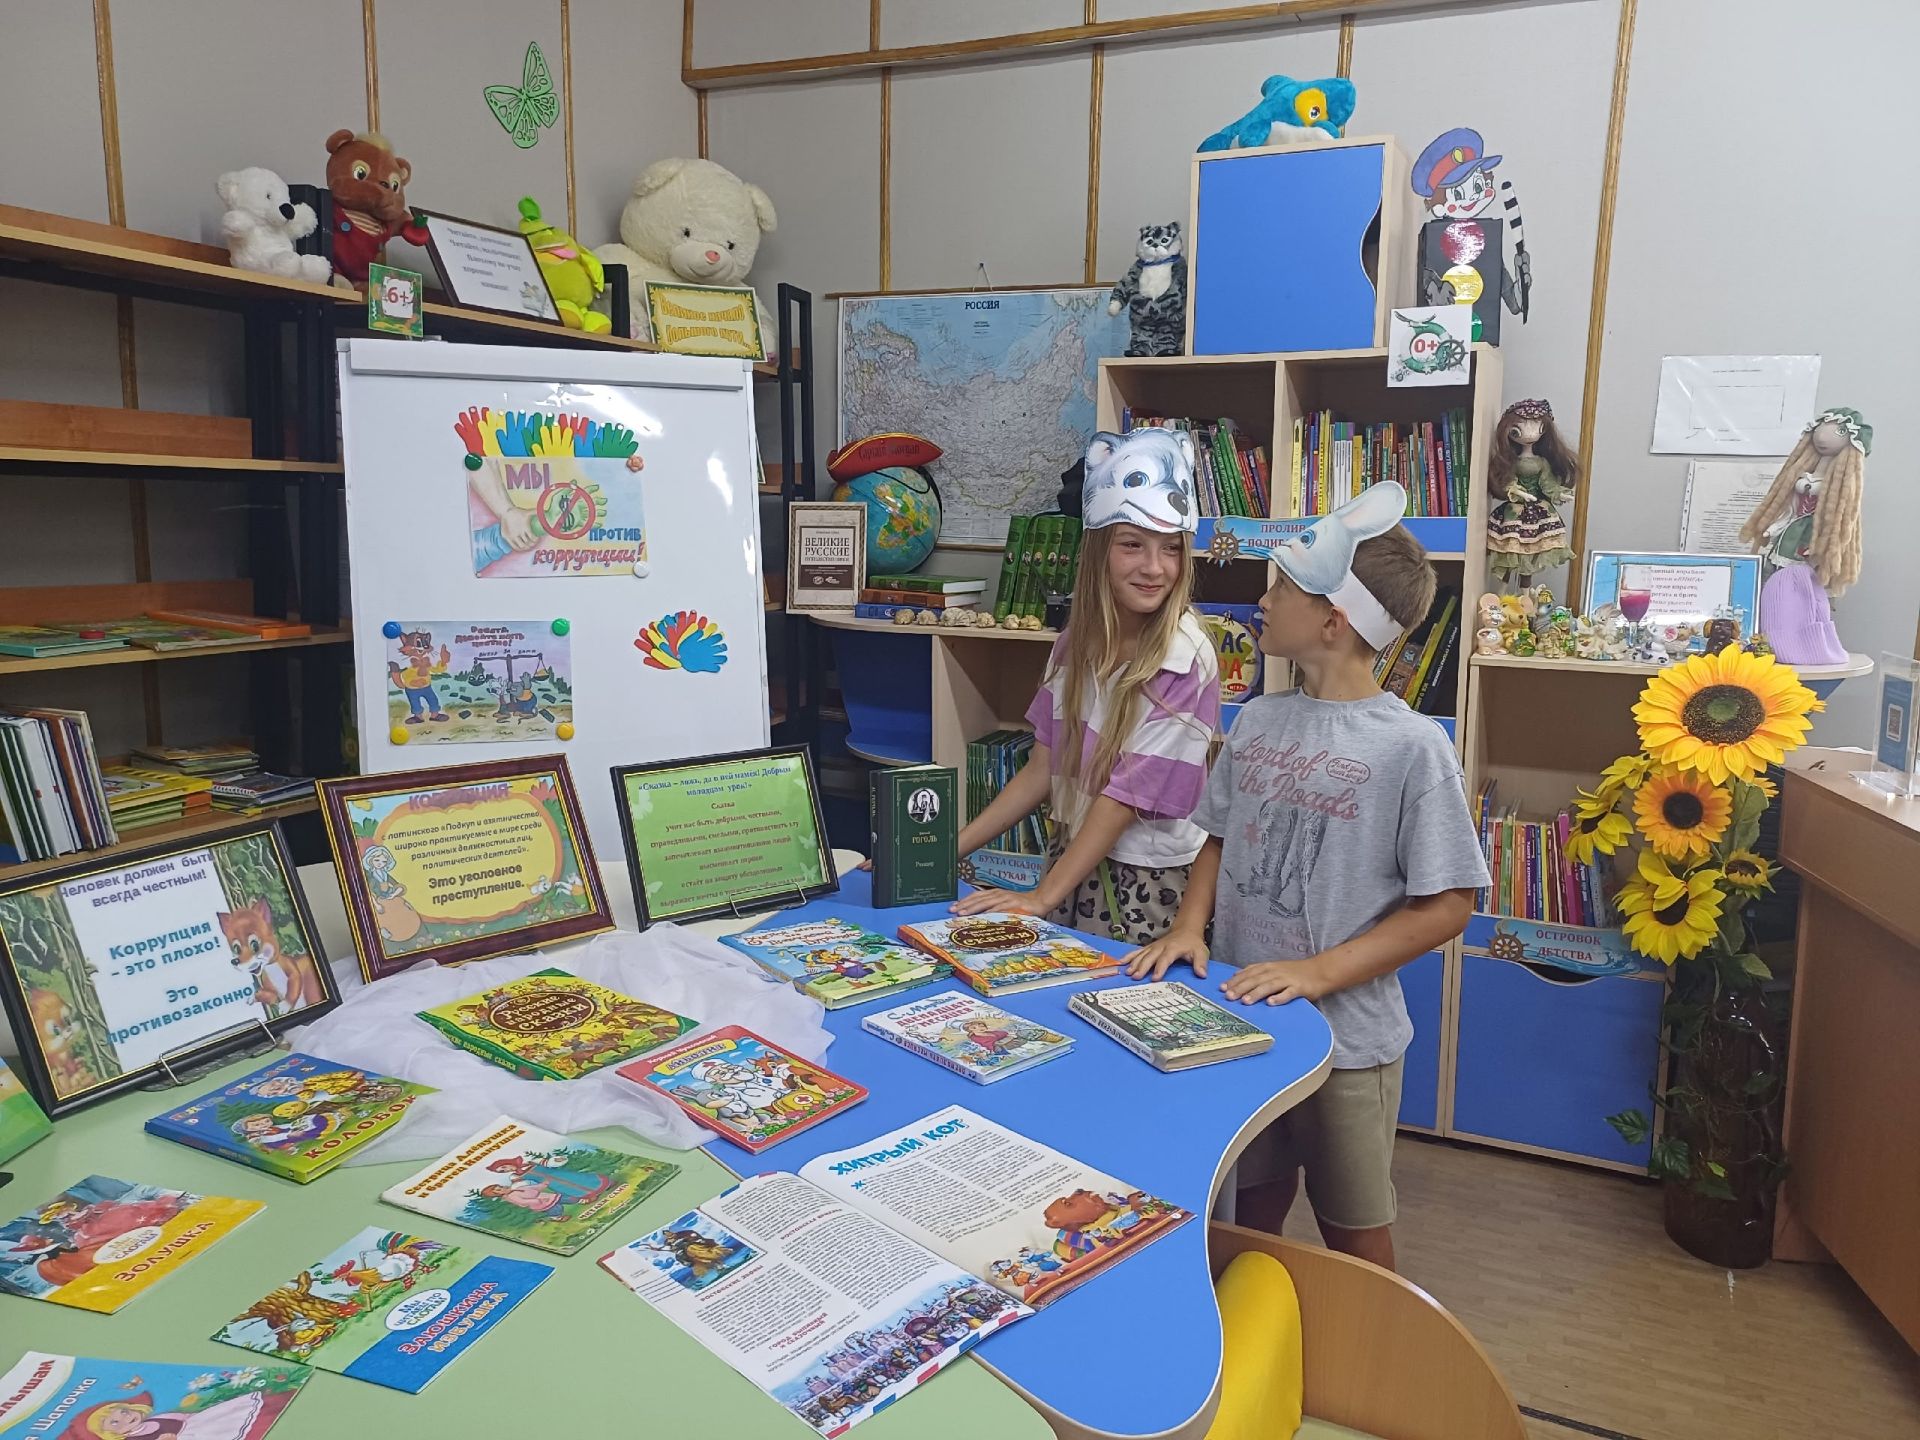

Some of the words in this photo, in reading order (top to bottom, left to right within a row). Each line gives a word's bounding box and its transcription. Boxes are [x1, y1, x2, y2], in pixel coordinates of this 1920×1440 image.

[387, 286, 409, 303] 6+
[964, 300, 1000, 310] РОССИЯ
[1413, 338, 1438, 353] 0+
[505, 463, 551, 490] МЫ
[589, 527, 642, 542] ПРОТИВ
[805, 537, 850, 547] ВЕЛИКИЕ
[805, 547, 850, 556] РУССКИЕ
[1233, 733, 1300, 769] Lord
[1292, 750, 1329, 781] of
[1238, 764, 1267, 796] the
[394, 838, 428, 851] широко
[499, 824, 519, 834] мире
[520, 821, 542, 832] среди
[475, 818, 482, 827] и
[912, 835, 938, 844] ГОГОЛЬ
[411, 847, 457, 862] различных
[422, 855, 482, 871] политических
[122, 861, 175, 885] должен
[181, 852, 215, 869] быть
[428, 874, 456, 889] Это
[457, 863, 523, 887] уголовное
[998, 872, 1026, 881] ТУКАЯ
[92, 887, 141, 908] всегда
[142, 868, 208, 894] честным!
[432, 877, 526, 906] преступление.
[108, 920, 213, 961] Коррупция
[1243, 927, 1270, 943] OOD
[1536, 929, 1602, 946] ОСТРОВОК
[124, 959, 156, 978] это
[161, 936, 221, 964] плохо!
[1537, 946, 1593, 961] ДЕТСТВА
[165, 983, 200, 1003] Это
[896, 999, 975, 1027] ДВЕНАДЦАТЬ
[918, 1007, 975, 1028] МЕСЯЦЕВ
[303, 1094, 417, 1160] КОЛОБОК
[828, 1137, 924, 1175] ХИТРЫЙ
[921, 1118, 967, 1141] КОТ
[404, 1159, 456, 1197] Сестрица
[428, 1163, 467, 1193] братец
[113, 1220, 215, 1282] ЗОЛУШКА
[398, 1281, 499, 1356] ЗАЮШКИНА
[428, 1291, 509, 1354] ИЗБУШКА
[0, 1359, 56, 1418] алышам
[38, 1376, 97, 1432] Шапочка
